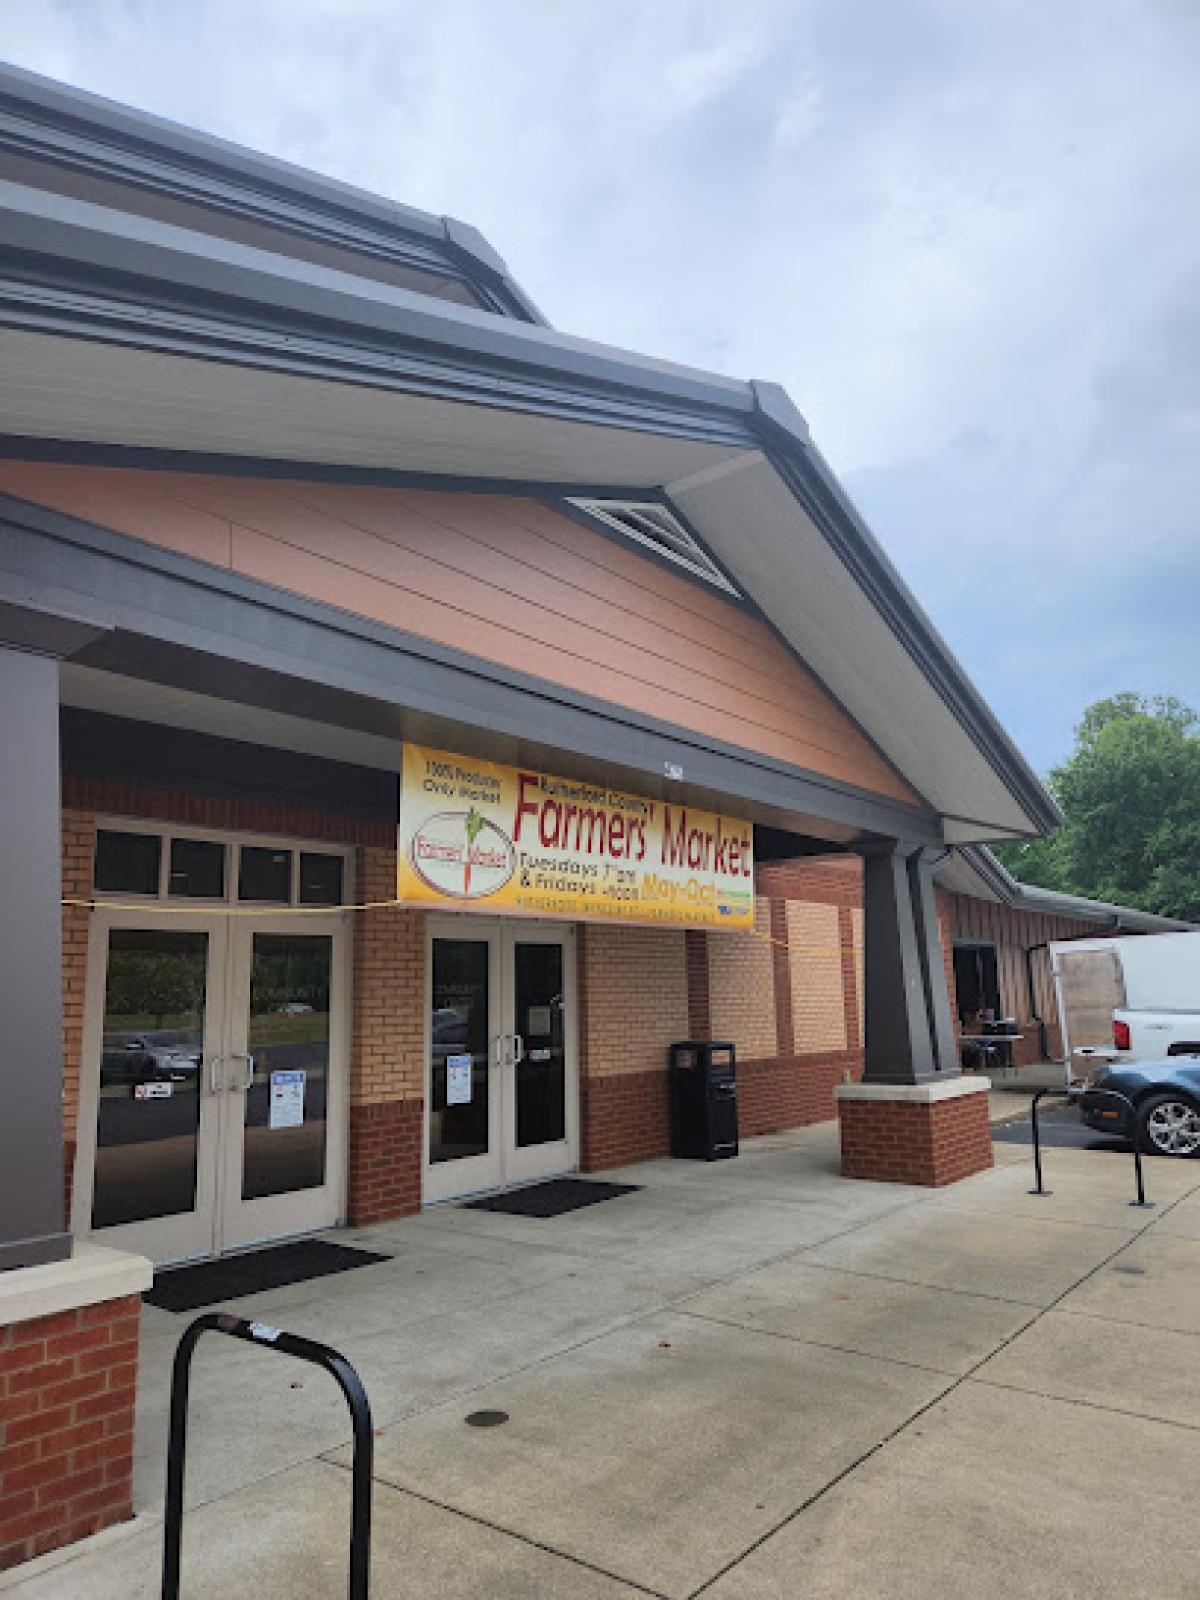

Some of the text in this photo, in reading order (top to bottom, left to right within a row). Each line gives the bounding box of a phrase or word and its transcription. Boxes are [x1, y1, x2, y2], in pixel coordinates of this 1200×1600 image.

[661, 806, 751, 877] Market
[520, 852, 598, 880] Tuesdays
[520, 868, 530, 887] &
[535, 873, 596, 896] Fridays
